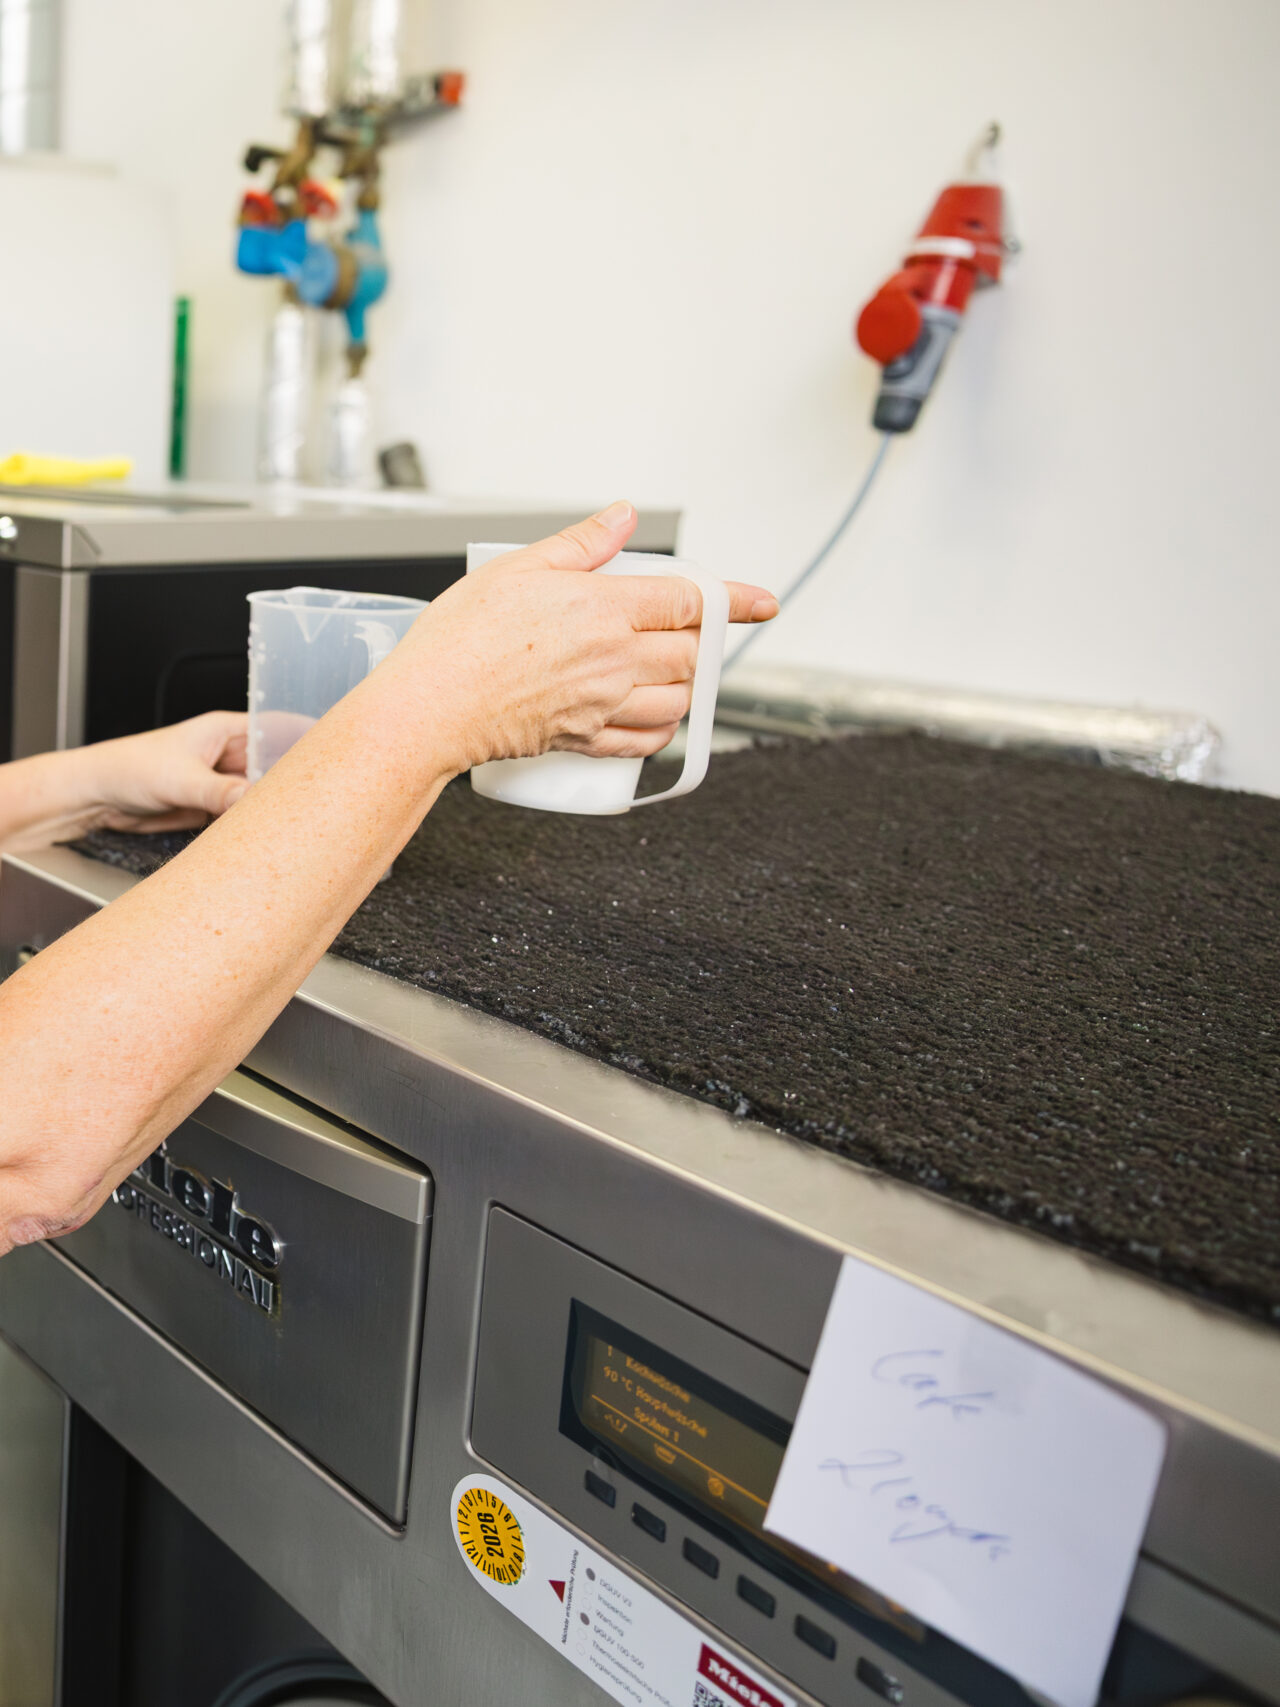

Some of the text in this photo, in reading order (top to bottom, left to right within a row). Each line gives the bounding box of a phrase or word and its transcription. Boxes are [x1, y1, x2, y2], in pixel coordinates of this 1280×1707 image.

[112, 1181, 273, 1314] OFESSIONAL
[464, 1494, 473, 1506] 3
[477, 1490, 483, 1502] 4
[491, 1496, 497, 1508] 5
[458, 1509, 468, 1519] 2
[504, 1513, 512, 1522] 6
[477, 1512, 504, 1558] 2026
[466, 1544, 478, 1560] 12
[482, 1560, 491, 1574] 11
[595, 1609, 624, 1637] Wartung
[707, 1657, 773, 1707] Miel
